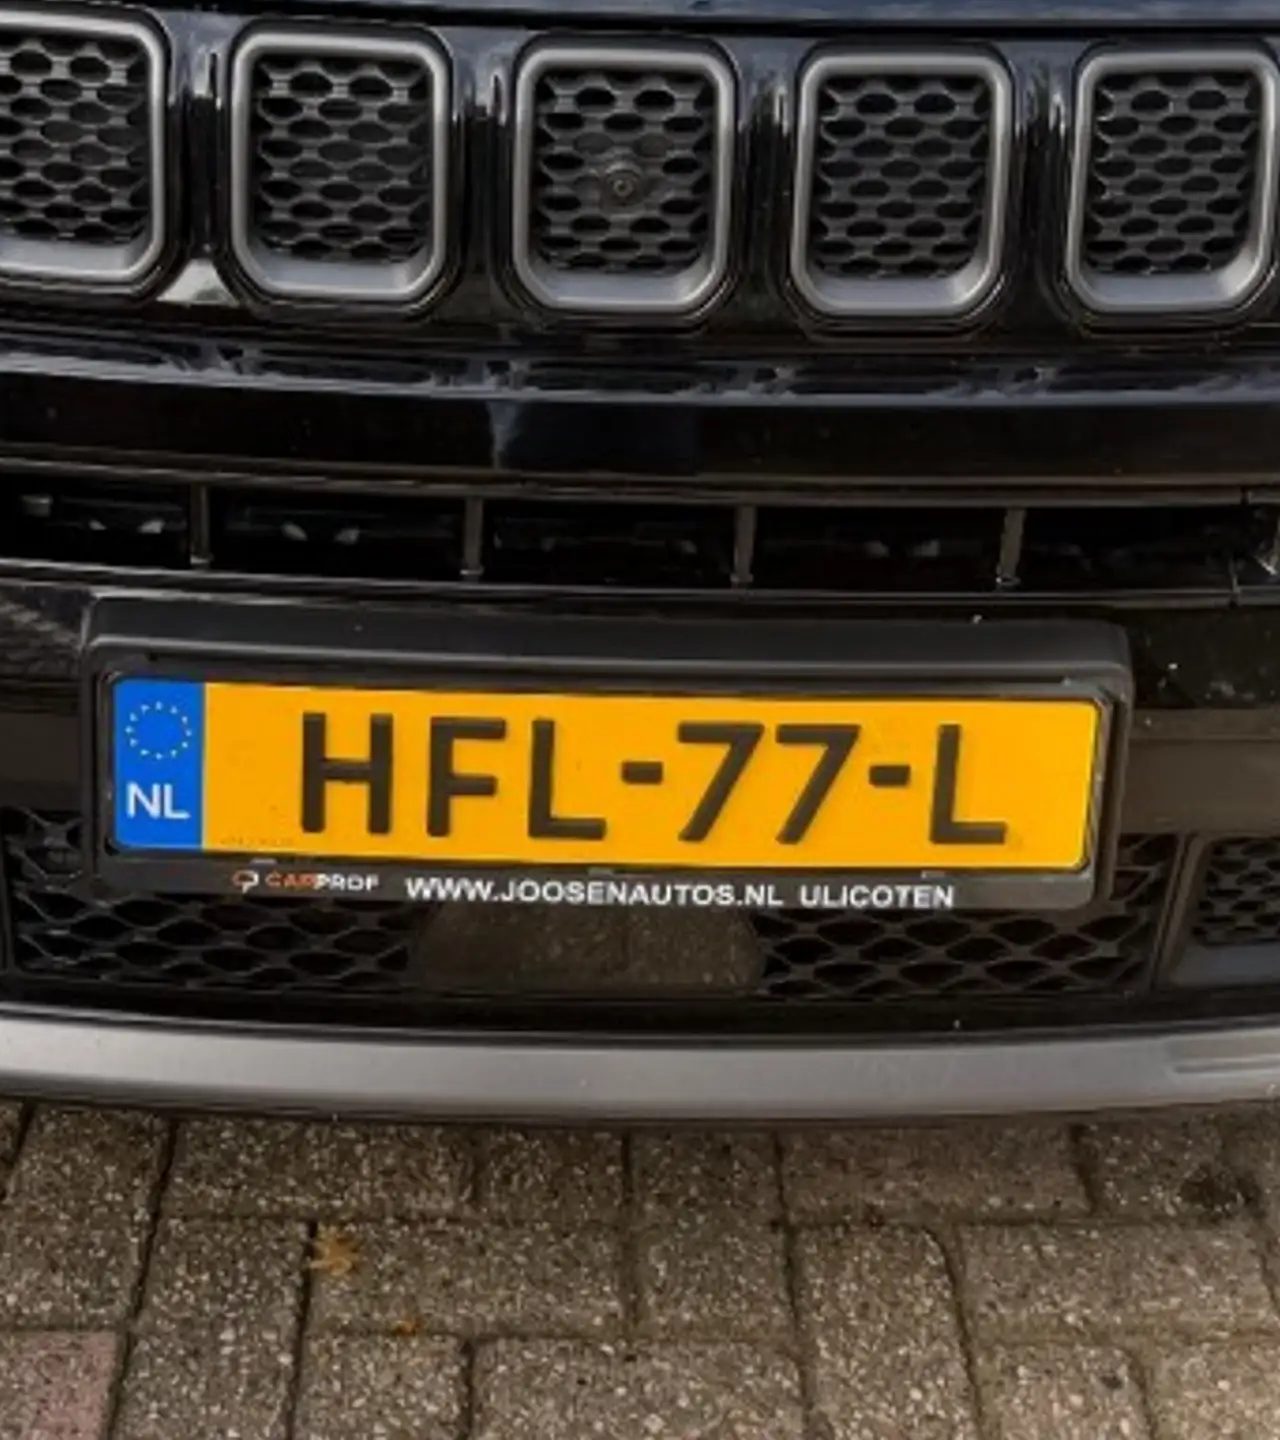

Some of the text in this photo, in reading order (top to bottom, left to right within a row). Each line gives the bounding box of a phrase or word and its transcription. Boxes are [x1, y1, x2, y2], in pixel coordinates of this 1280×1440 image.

[299, 711, 1008, 846] HFL-77-L
[126, 781, 191, 820] NL
[264, 870, 380, 892] CARPROF
[405, 876, 955, 908] WWW.JOOSENAUTOS.NL ULICOTEN
